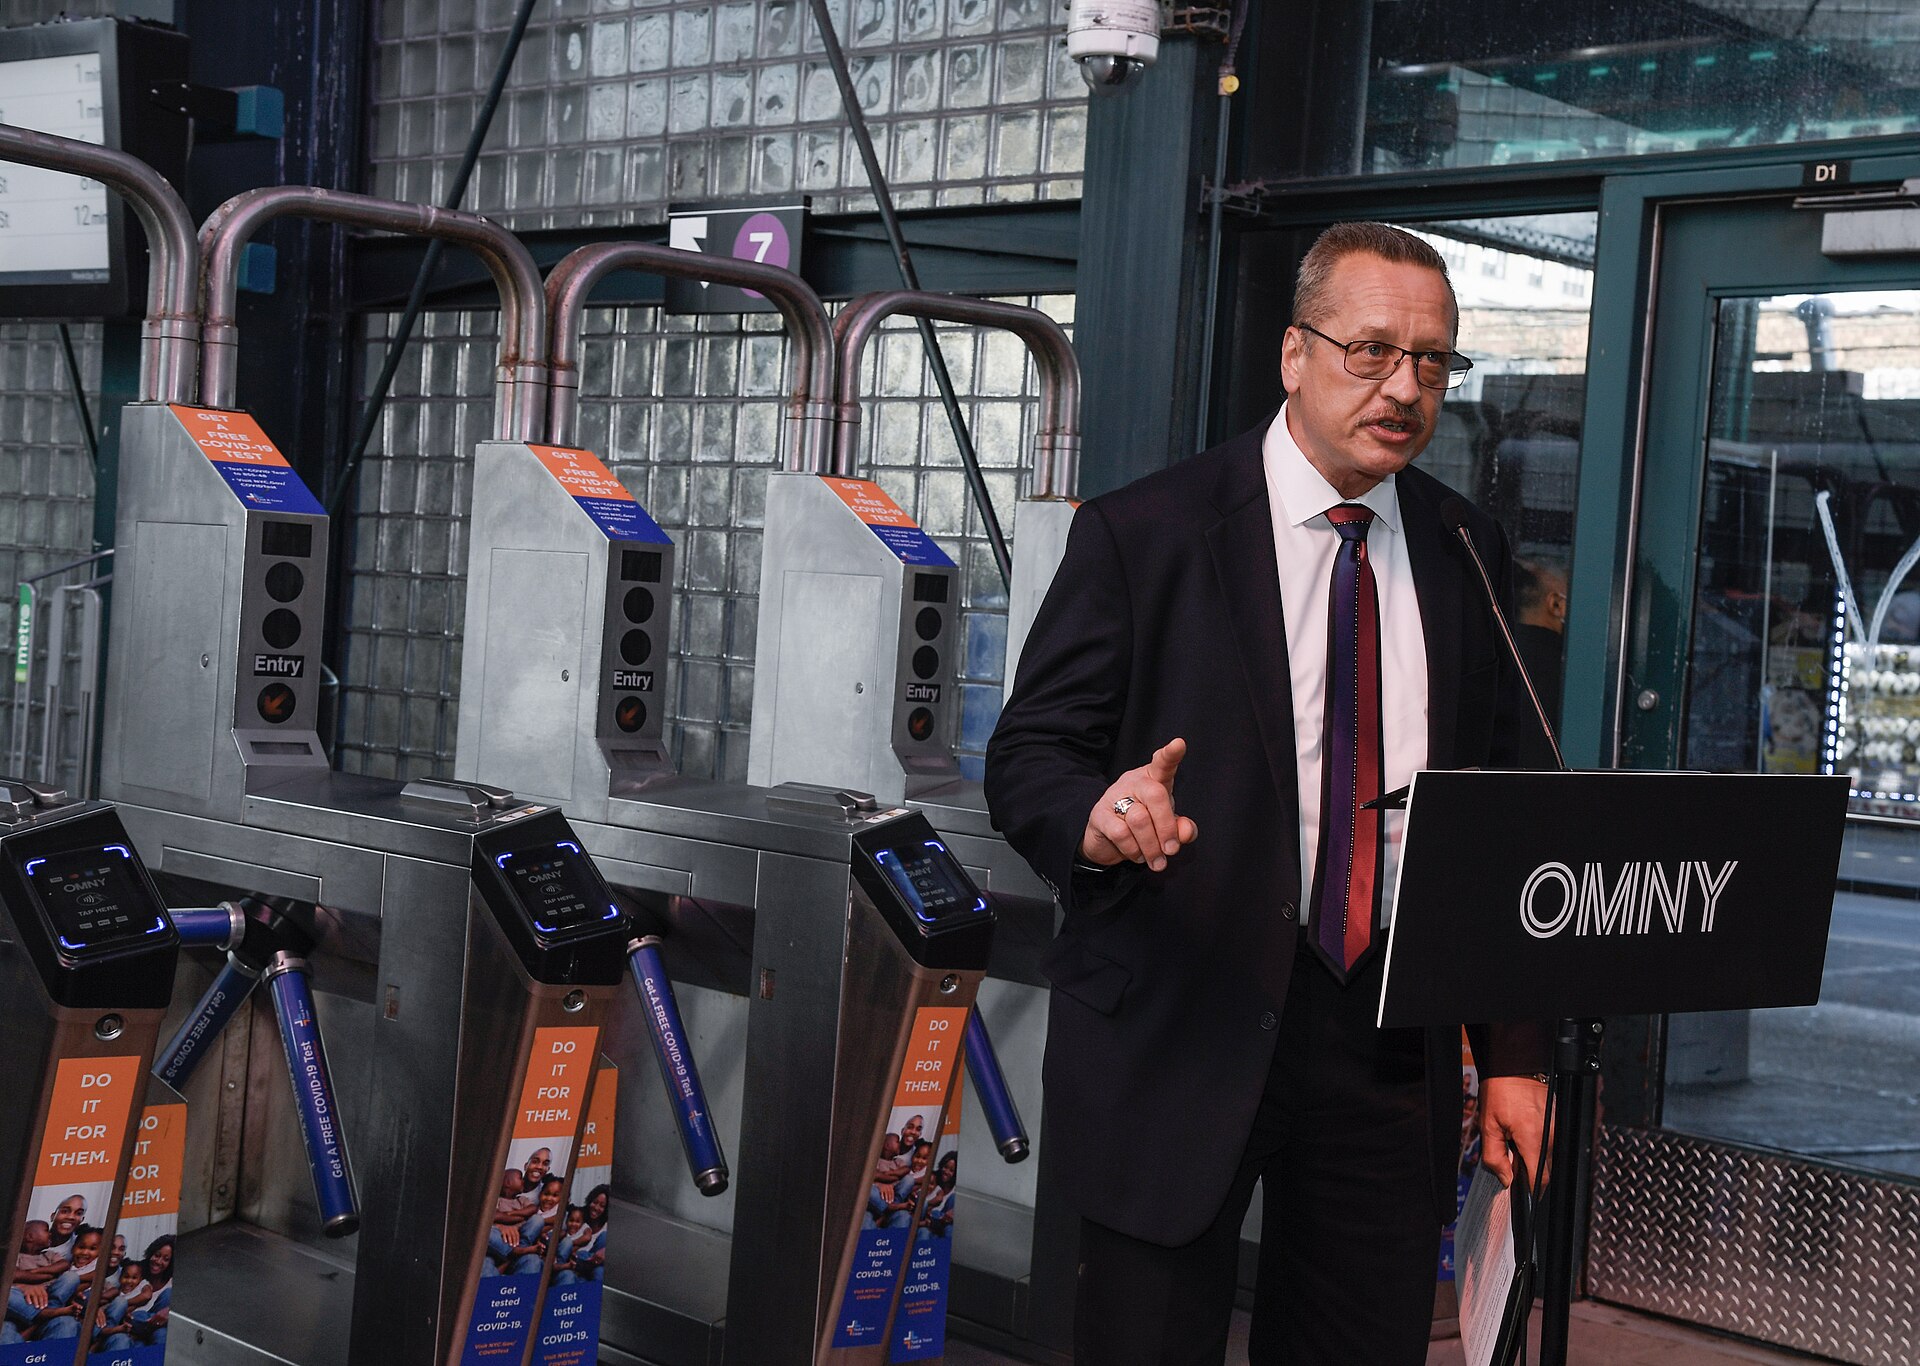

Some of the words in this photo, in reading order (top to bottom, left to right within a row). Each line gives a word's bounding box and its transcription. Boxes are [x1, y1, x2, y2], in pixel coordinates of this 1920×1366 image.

[1815, 164, 1837, 182] D1
[75, 205, 91, 226] 12
[749, 232, 773, 264] 7
[197, 413, 229, 423] GET
[216, 423, 229, 431] A
[207, 431, 251, 442] FREE
[198, 439, 273, 453] COVID-19
[222, 450, 263, 460] TEST
[551, 451, 579, 460] GET
[563, 468, 600, 478] FREE
[558, 475, 619, 488] COVID-19
[841, 482, 864, 490] GET
[579, 485, 613, 496] TEST
[853, 498, 885, 507] FREE
[851, 505, 904, 517] COVID-19
[870, 514, 899, 523] TEST
[254, 655, 302, 677] Entry
[613, 671, 652, 691] Entry
[906, 684, 938, 702] Entry
[528, 870, 562, 884] OMNY
[63, 877, 107, 893] OMNY
[557, 893, 577, 902] HERE
[1519, 860, 1739, 939] OMNY
[77, 908, 94, 917] TAP
[95, 904, 119, 915] HERE
[644, 977, 657, 997] Get
[211, 991, 226, 1008] Get
[650, 996, 661, 1006] A
[653, 1003, 670, 1031] FREE
[190, 1014, 211, 1040] FREE
[928, 1020, 949, 1032] DO
[300, 1040, 315, 1063] Test
[551, 1041, 576, 1054] DO
[927, 1040, 940, 1052] IT
[166, 1039, 196, 1078] COVID-19
[664, 1031, 687, 1077] COVID-19
[551, 1064, 567, 1077] IT
[915, 1060, 942, 1072] FOR
[80, 1073, 112, 1088] DO
[681, 1076, 695, 1098] Test
[904, 1080, 942, 1093] THEM.
[306, 1064, 328, 1114] COVID-19
[537, 1086, 571, 1100] FOR
[81, 1099, 101, 1114] IT
[525, 1108, 572, 1123] THEM.
[64, 1124, 107, 1141] FOR
[319, 1115, 336, 1145] FREE
[134, 1140, 151, 1156] IT
[327, 1147, 339, 1157] A
[50, 1150, 110, 1167] THEM.
[129, 1164, 160, 1180] OR
[332, 1158, 344, 1179] Get
[875, 1238, 890, 1247] Get
[867, 1248, 893, 1258] tested
[917, 1247, 932, 1256] Get
[871, 1260, 883, 1268] for
[912, 1258, 936, 1269] tested
[855, 1269, 893, 1280] COVID-19.
[917, 1272, 929, 1281] for
[499, 1286, 517, 1295] Get
[903, 1282, 941, 1295] COVID-19.
[491, 1297, 521, 1308] tested
[560, 1292, 578, 1302] Get
[495, 1310, 511, 1319] for
[553, 1304, 583, 1317] tested
[476, 1320, 523, 1332] COVID-19.
[559, 1320, 575, 1330] for
[542, 1330, 589, 1346] COVID-19.
[24, 1354, 47, 1364] Get
[111, 1358, 133, 1366] Get
